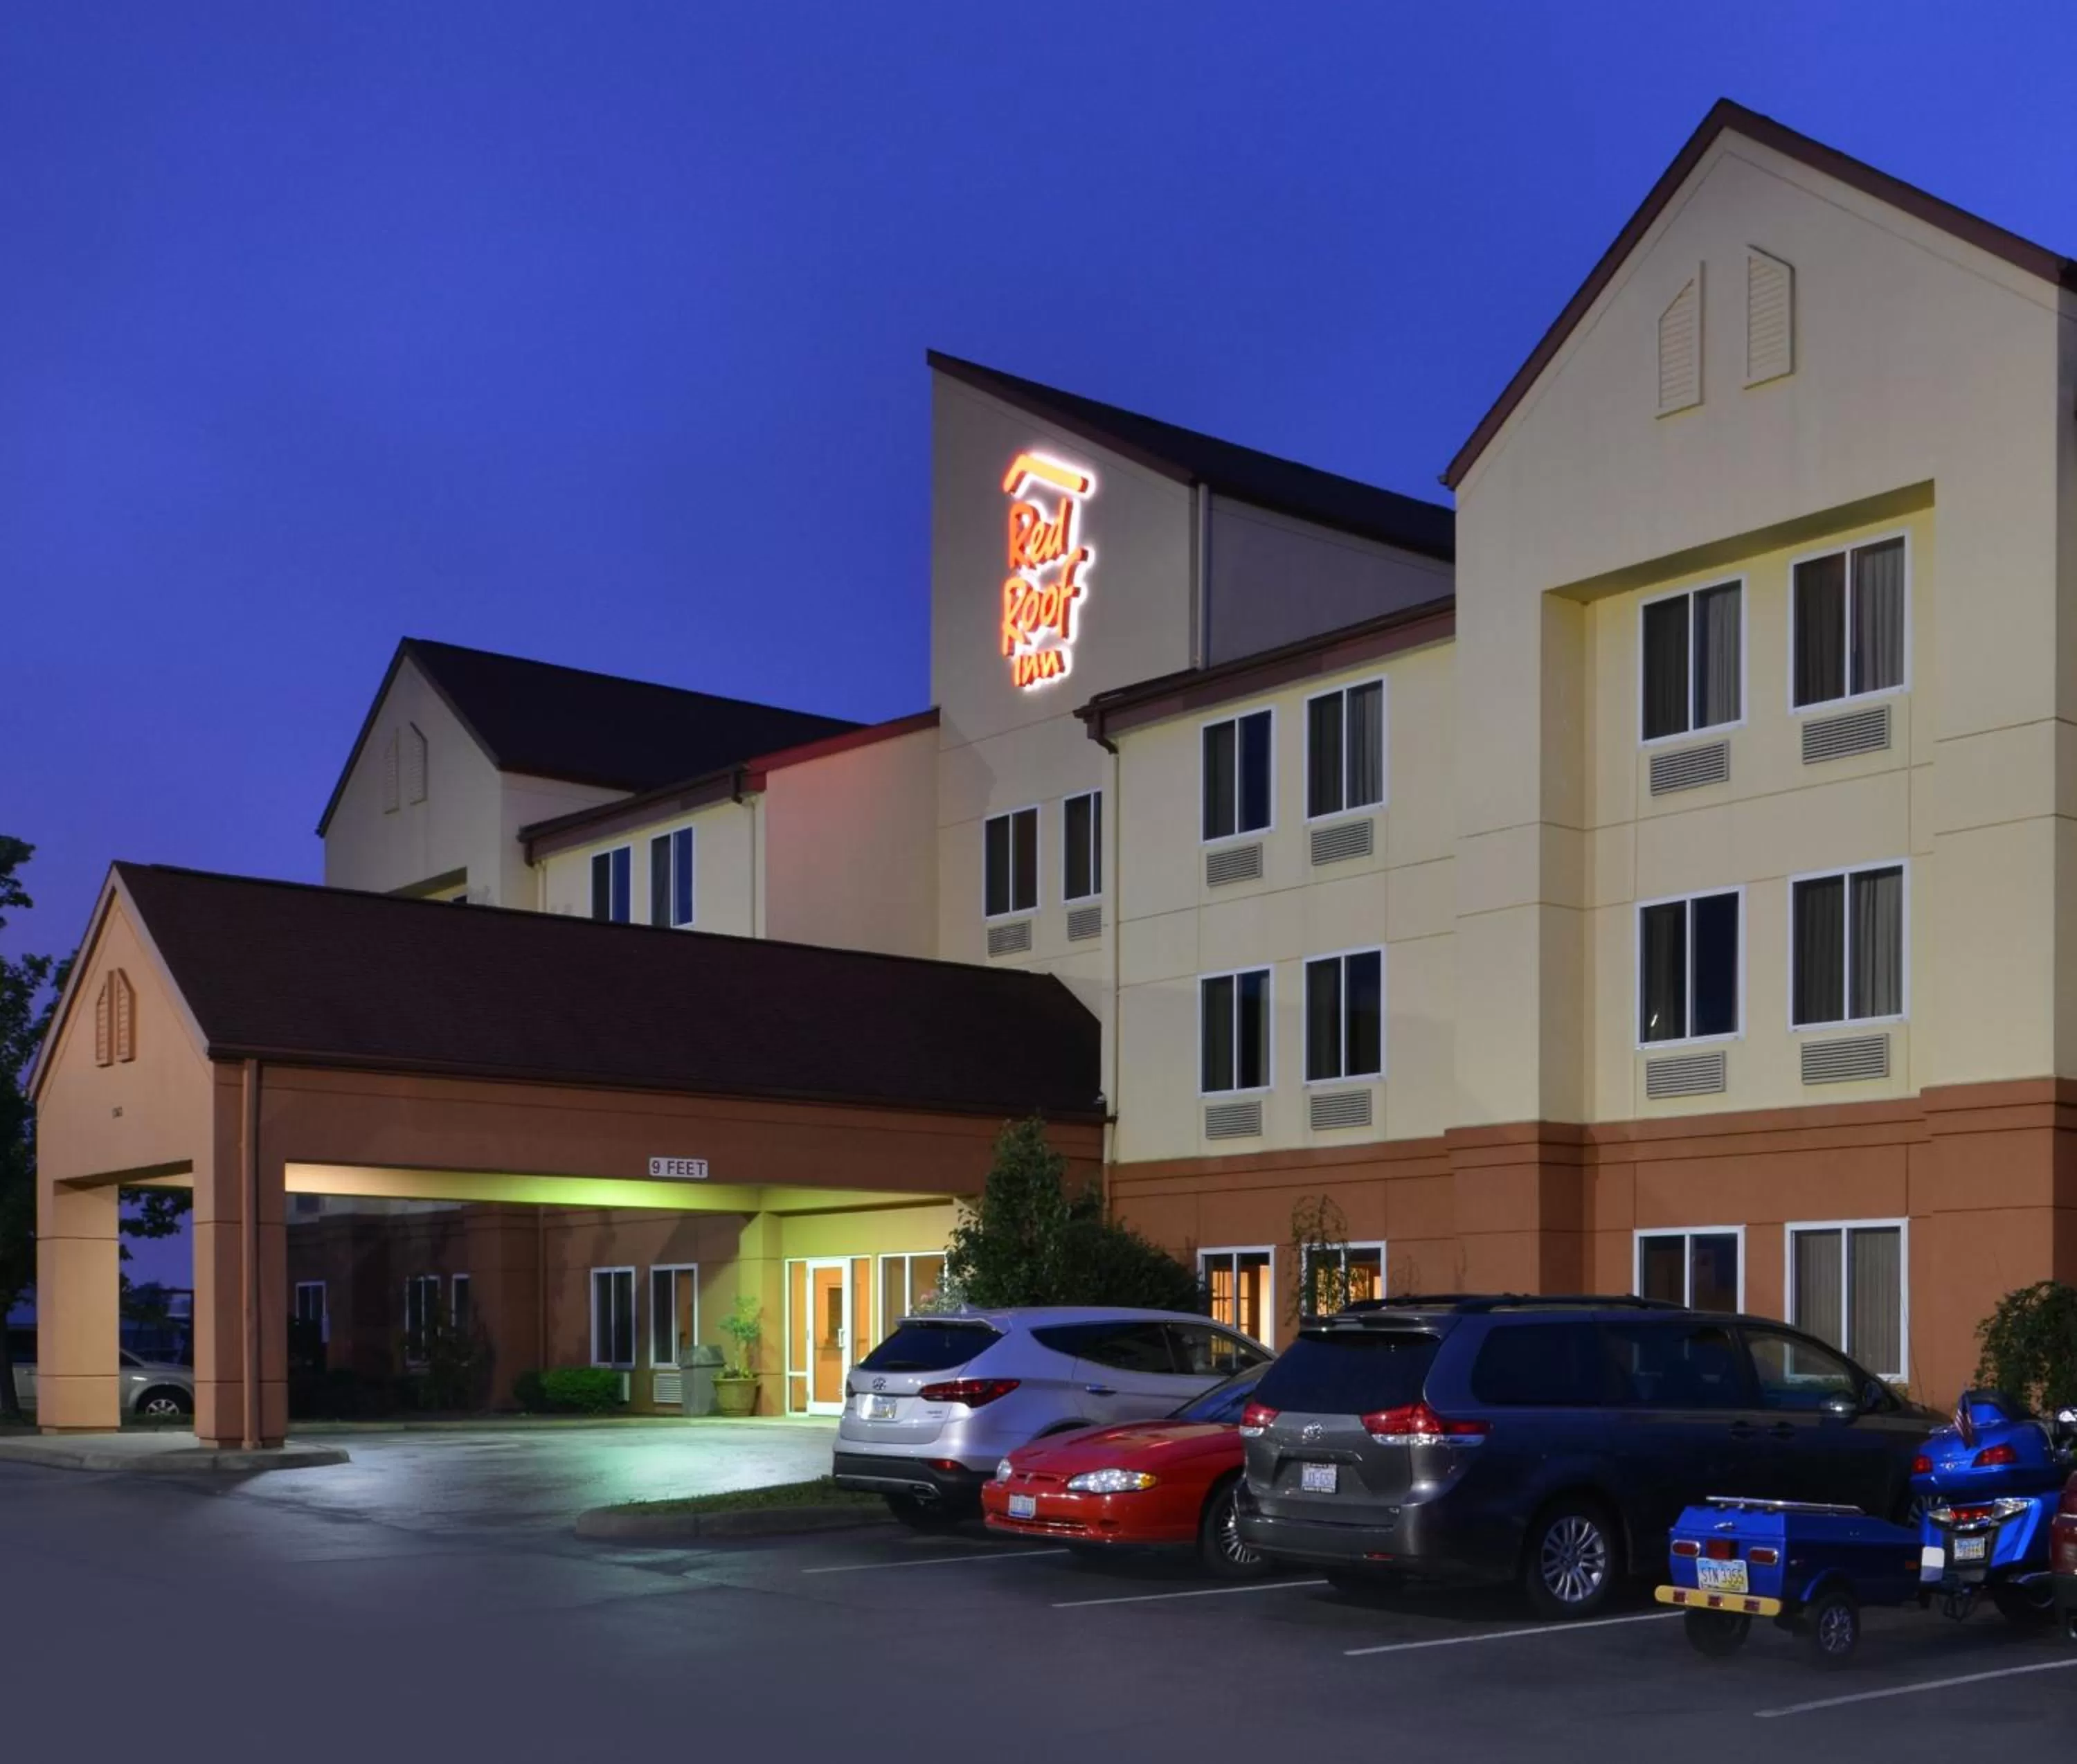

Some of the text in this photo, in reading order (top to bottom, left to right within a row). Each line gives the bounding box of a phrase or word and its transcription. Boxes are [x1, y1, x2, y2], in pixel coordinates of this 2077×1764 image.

[1009, 498, 1073, 570] Red
[1002, 547, 1088, 656] Roof
[651, 1160, 705, 1176] 9 FEET
